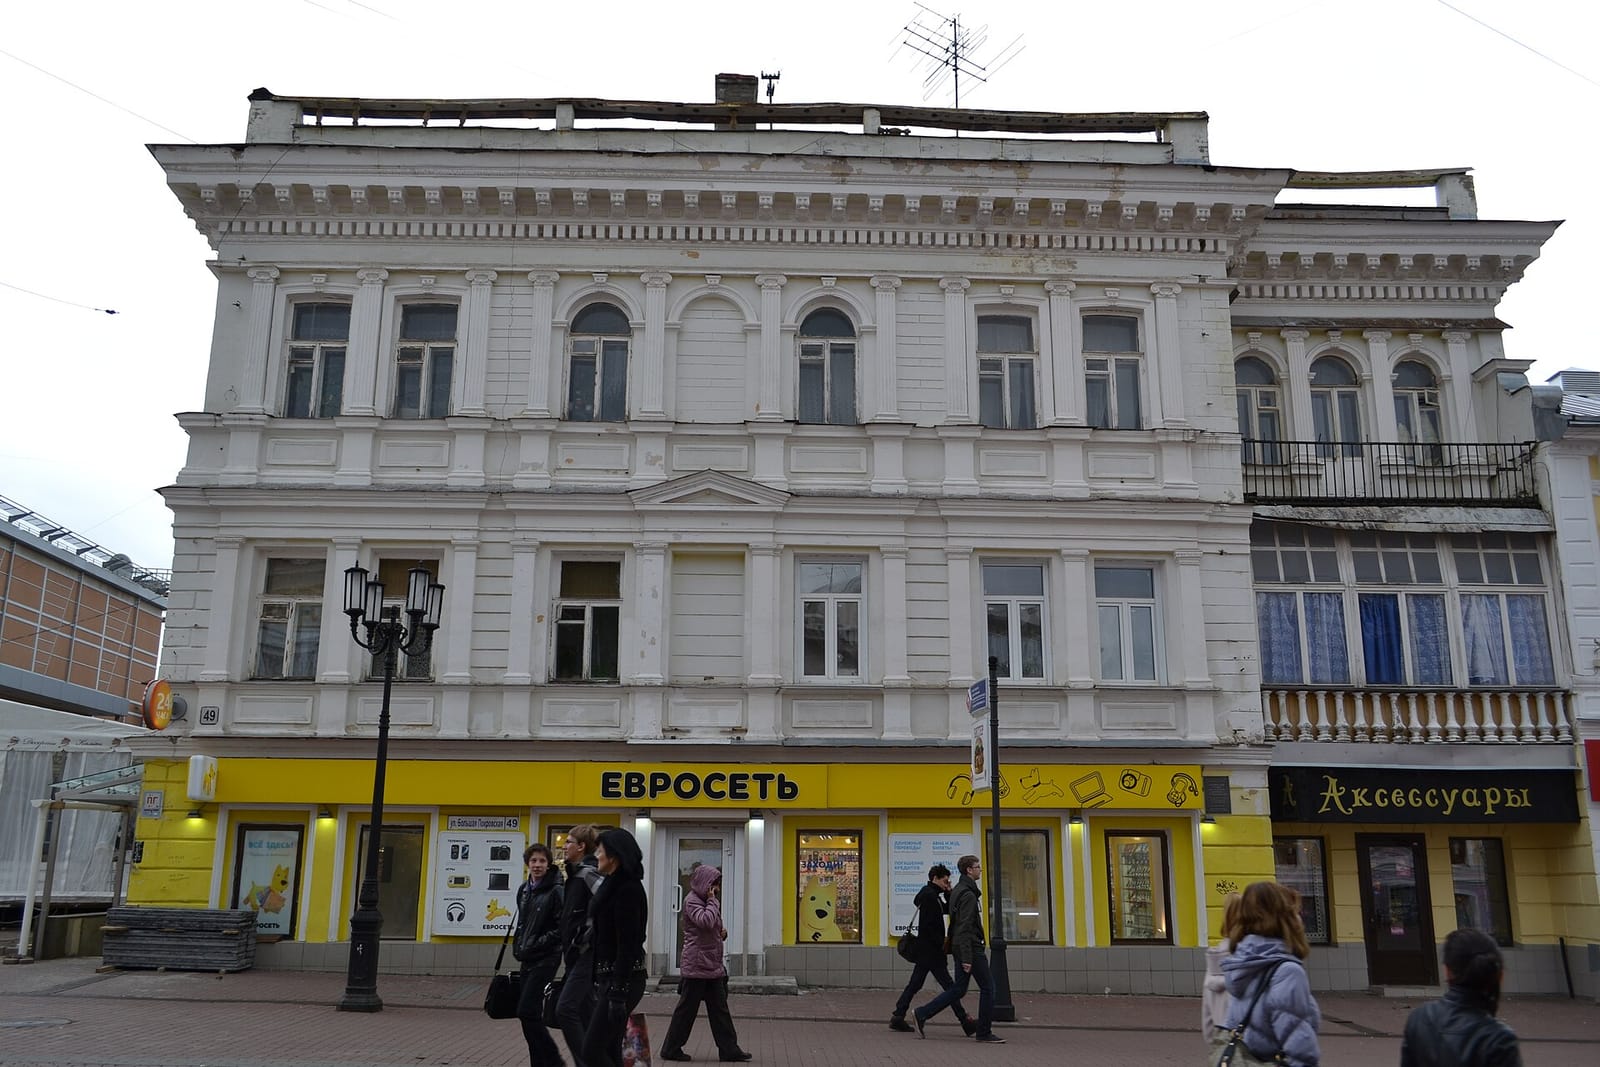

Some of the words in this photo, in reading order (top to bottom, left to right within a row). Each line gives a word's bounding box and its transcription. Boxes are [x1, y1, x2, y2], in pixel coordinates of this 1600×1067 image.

[157, 693, 170, 710] 24
[203, 710, 216, 721] 49
[601, 772, 799, 800] ЕВРОСЕТЬ
[1318, 775, 1533, 815] Аксессуары
[506, 818, 518, 828] 49
